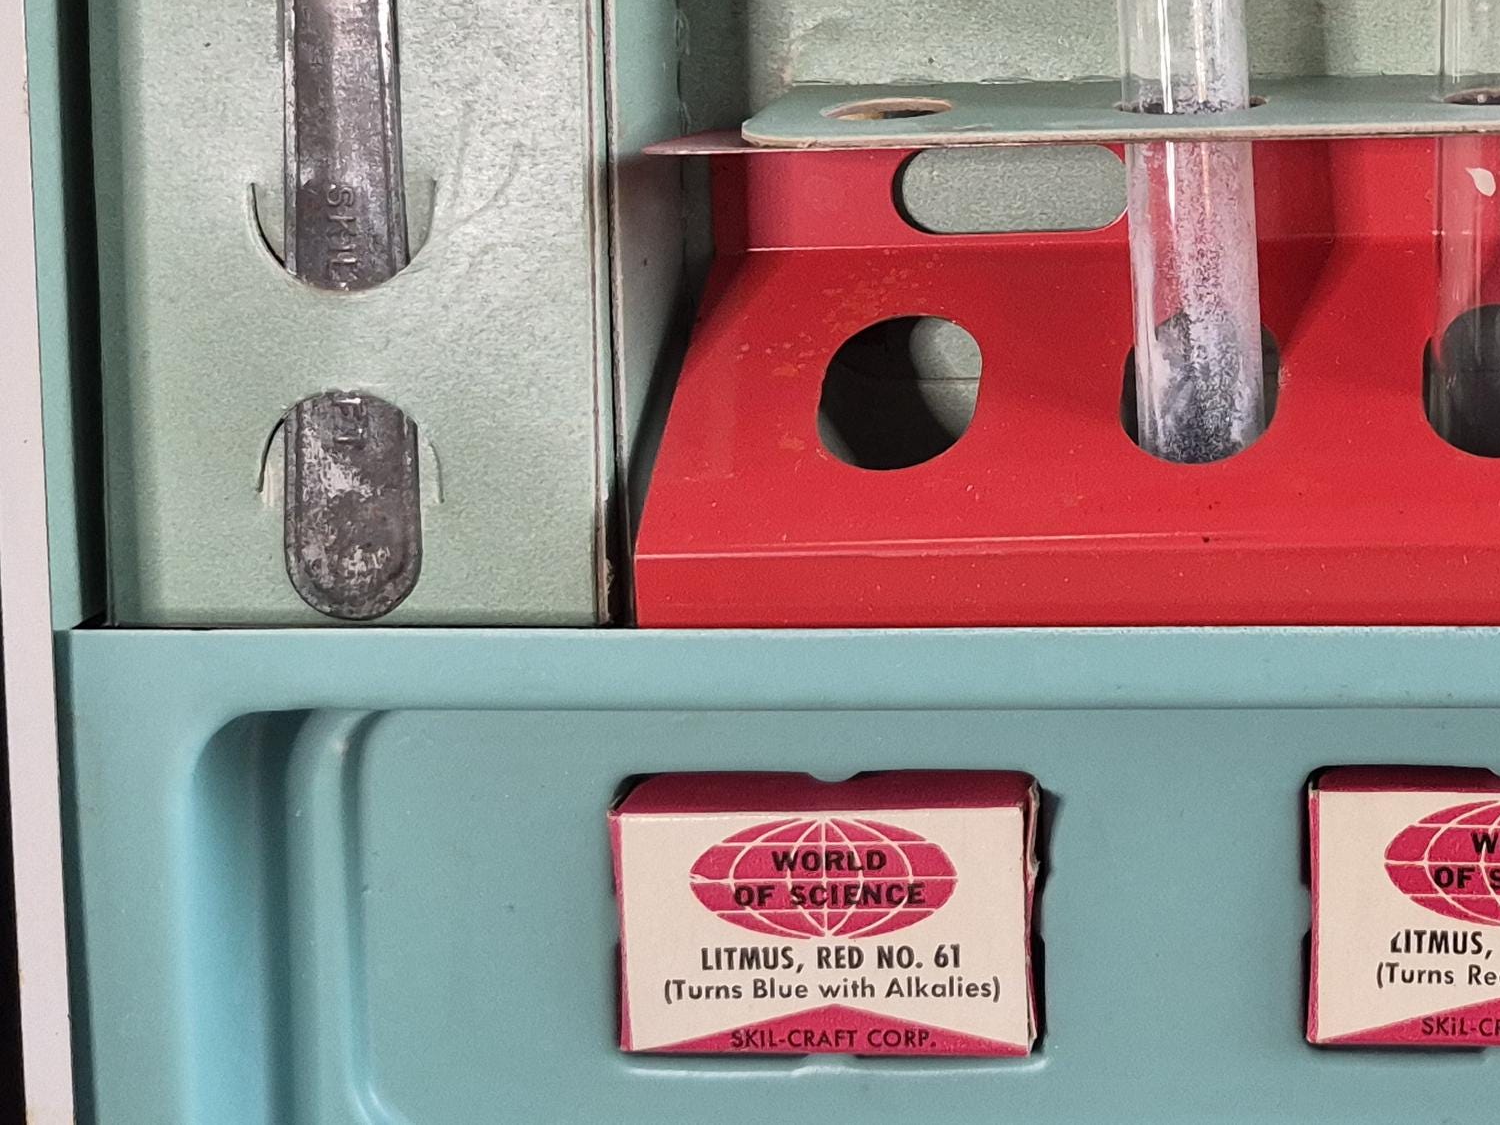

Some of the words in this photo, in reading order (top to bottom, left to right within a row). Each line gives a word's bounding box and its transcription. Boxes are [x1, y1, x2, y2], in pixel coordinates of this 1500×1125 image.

[771, 849, 887, 872] WORLD
[1434, 866, 1475, 889] OF
[734, 884, 775, 907] OF
[790, 882, 926, 907] SCIENCE
[1390, 929, 1493, 960] LITMUS,
[701, 945, 805, 974] LITMUS,
[816, 945, 864, 970] RED
[876, 944, 923, 970] NO.
[934, 943, 961, 969] 61
[1376, 961, 1455, 989] (Turns
[664, 977, 743, 1004] (Turns
[752, 977, 809, 1000] Blue
[818, 976, 876, 999] with
[885, 975, 1002, 1002] Alkalies)
[730, 1028, 859, 1049] SKIL-CRAFT
[867, 1029, 936, 1049] CORP.
